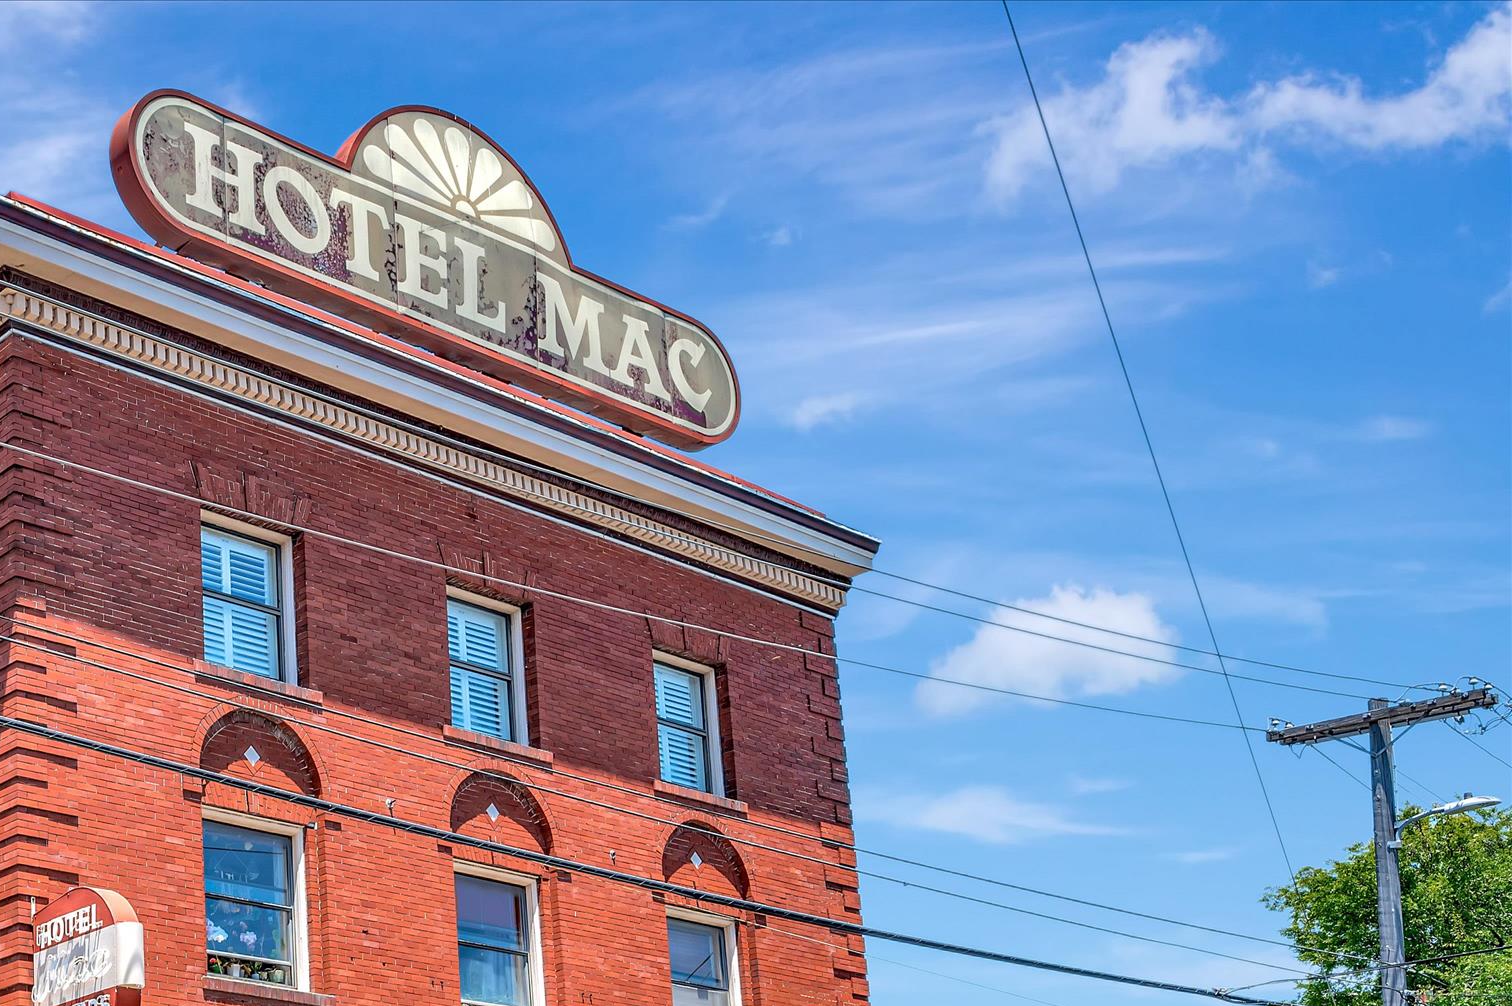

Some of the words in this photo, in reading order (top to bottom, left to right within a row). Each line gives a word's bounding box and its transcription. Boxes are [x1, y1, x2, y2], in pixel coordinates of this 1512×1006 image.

[183, 120, 507, 334] HOTEL
[537, 272, 713, 409] MAC
[36, 903, 104, 949] HOTEL
